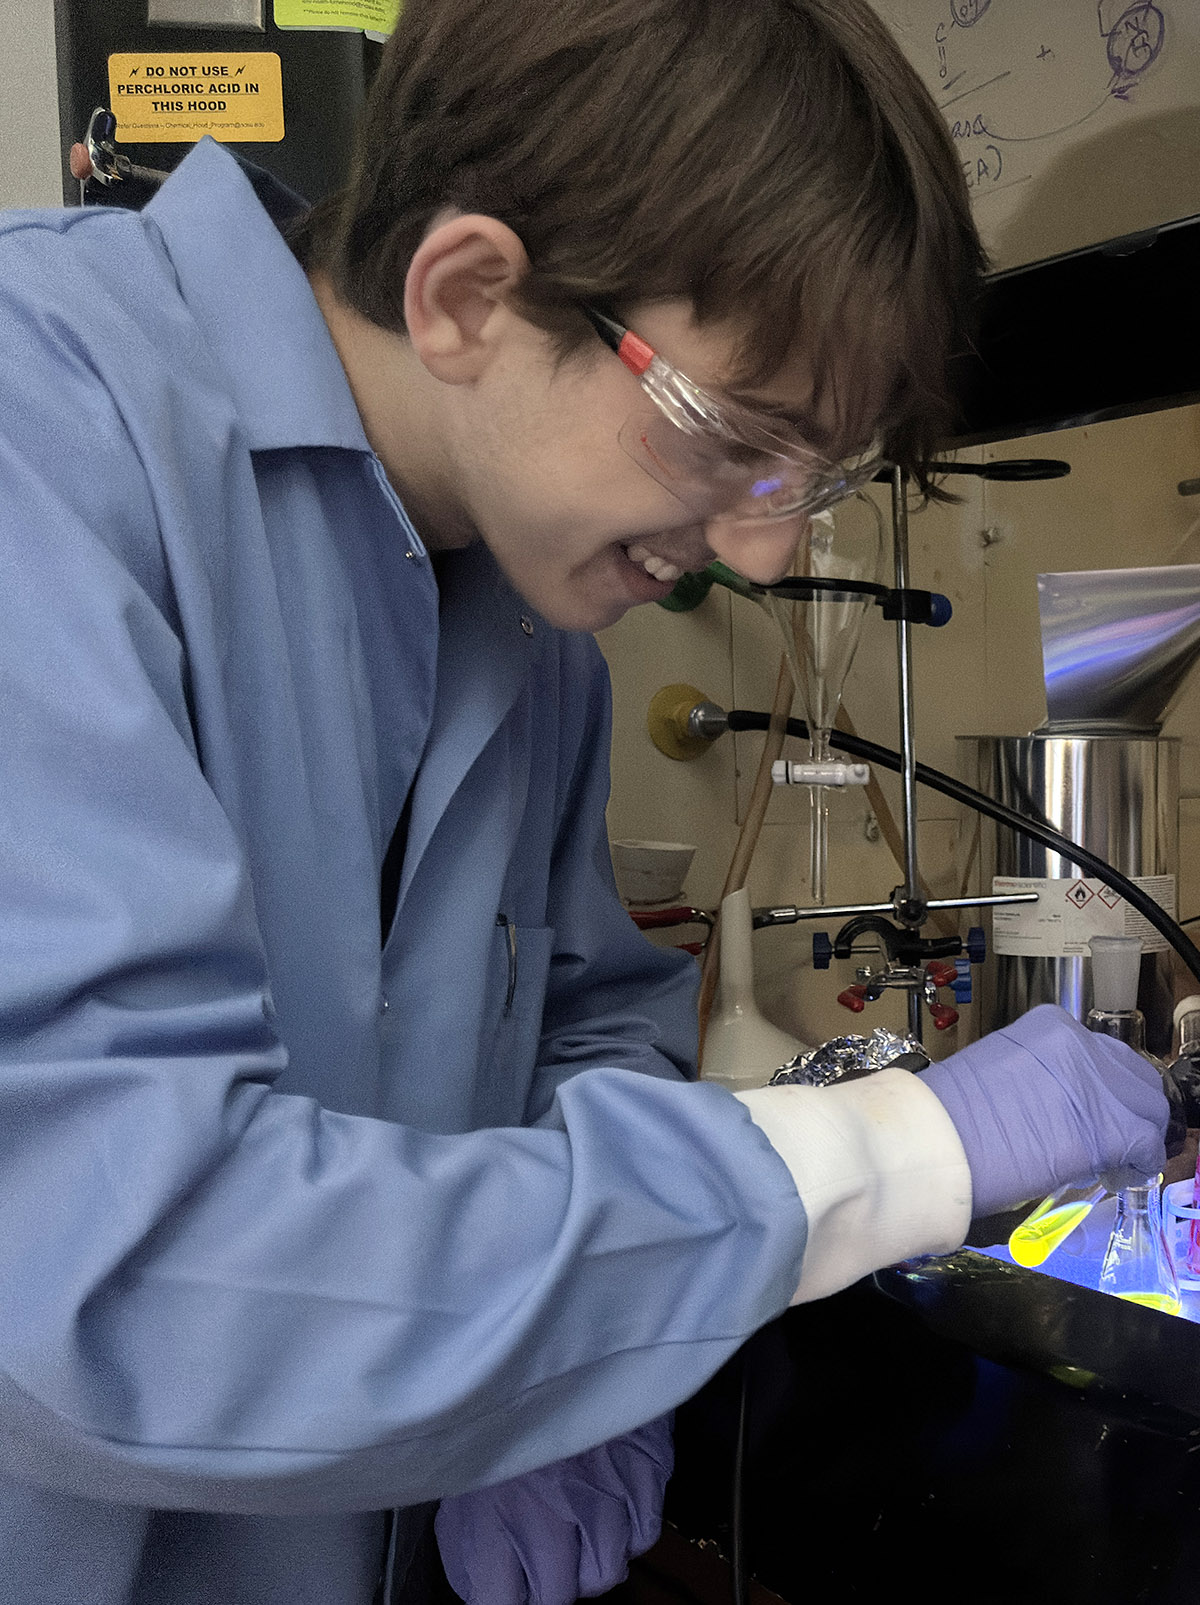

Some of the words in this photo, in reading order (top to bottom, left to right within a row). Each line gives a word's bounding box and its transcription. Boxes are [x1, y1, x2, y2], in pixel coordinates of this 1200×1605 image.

[146, 66, 165, 77] DO
[169, 66, 197, 76] NOT
[202, 66, 229, 76] USE
[117, 84, 204, 95] PERCHLORIC
[208, 83, 241, 94] ACID
[245, 83, 260, 93] IN
[151, 101, 184, 112] THIS
[187, 101, 227, 111] HOOD
